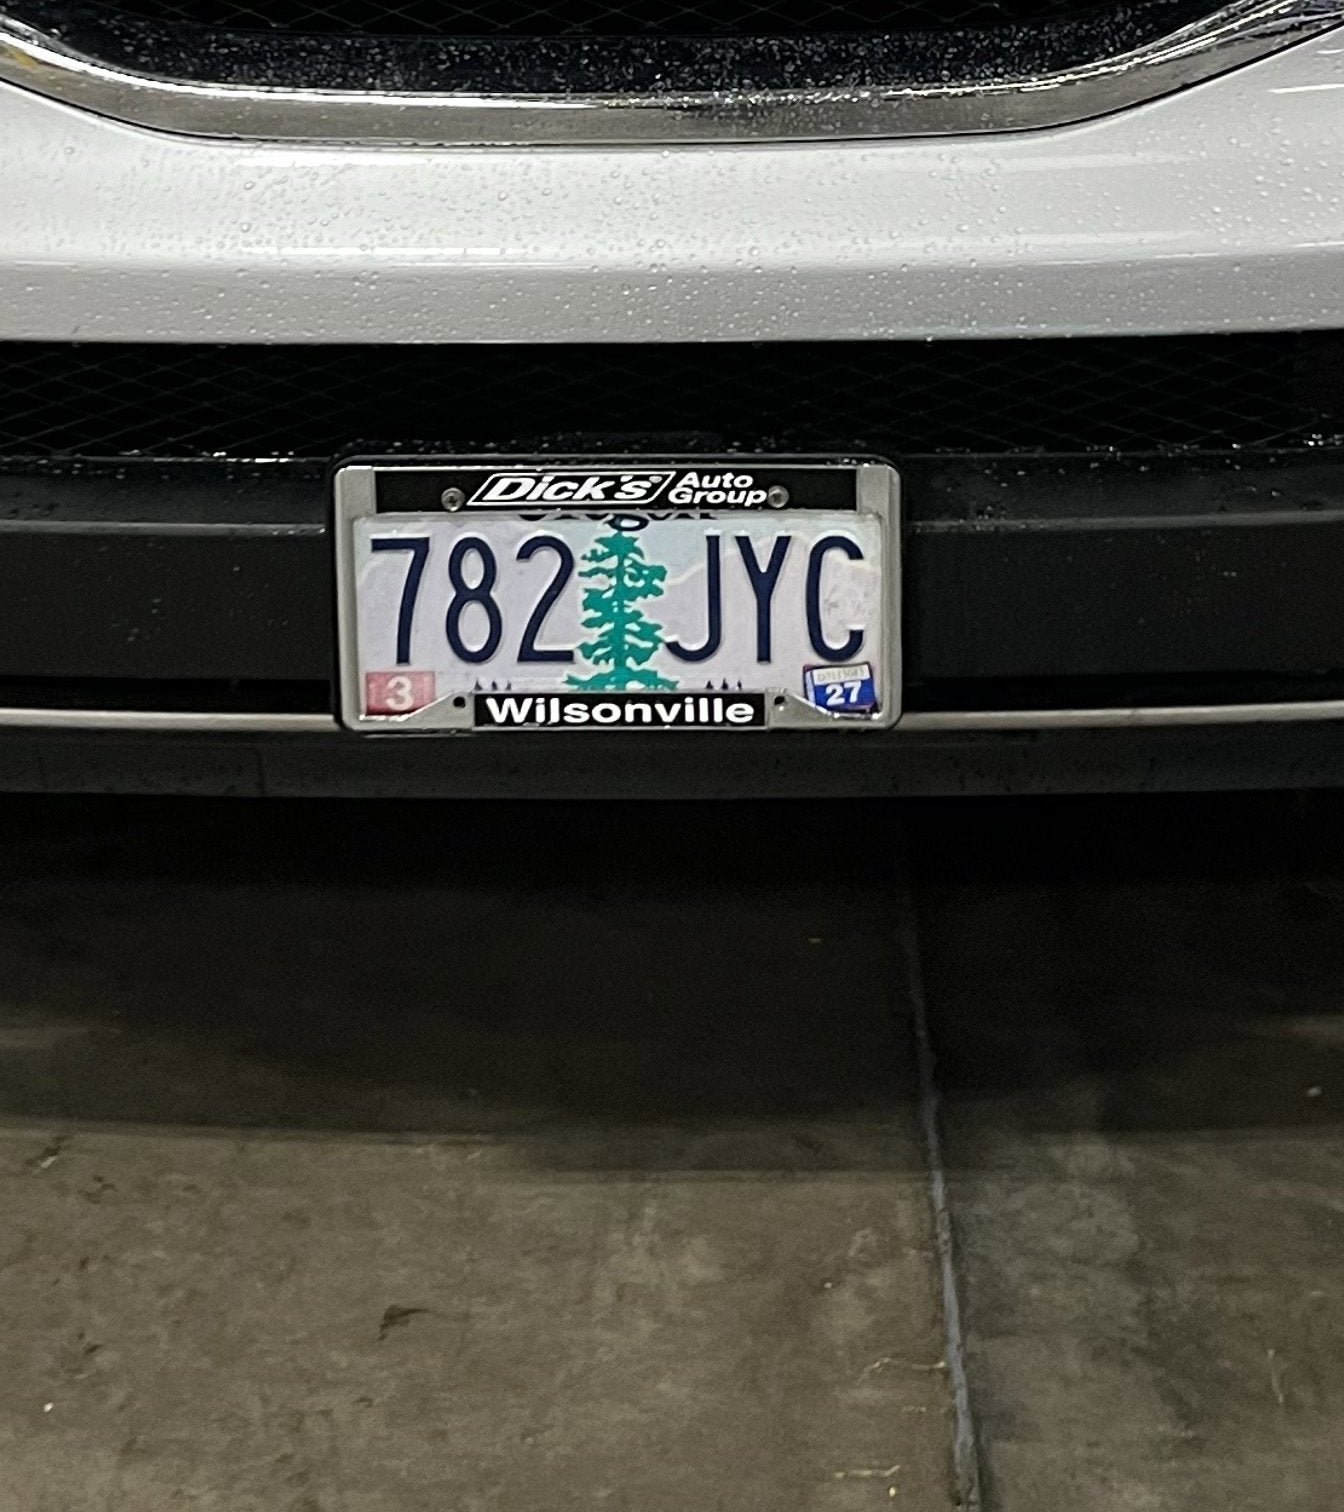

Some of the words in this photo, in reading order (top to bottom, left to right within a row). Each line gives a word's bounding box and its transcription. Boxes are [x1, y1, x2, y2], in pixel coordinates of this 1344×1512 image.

[675, 472, 753, 488] Auto
[668, 487, 767, 506] Group
[370, 535, 575, 665] 782
[665, 535, 865, 664] JYC
[386, 675, 414, 711] 3
[825, 680, 862, 706] 27
[486, 697, 755, 724] Wilsonville
